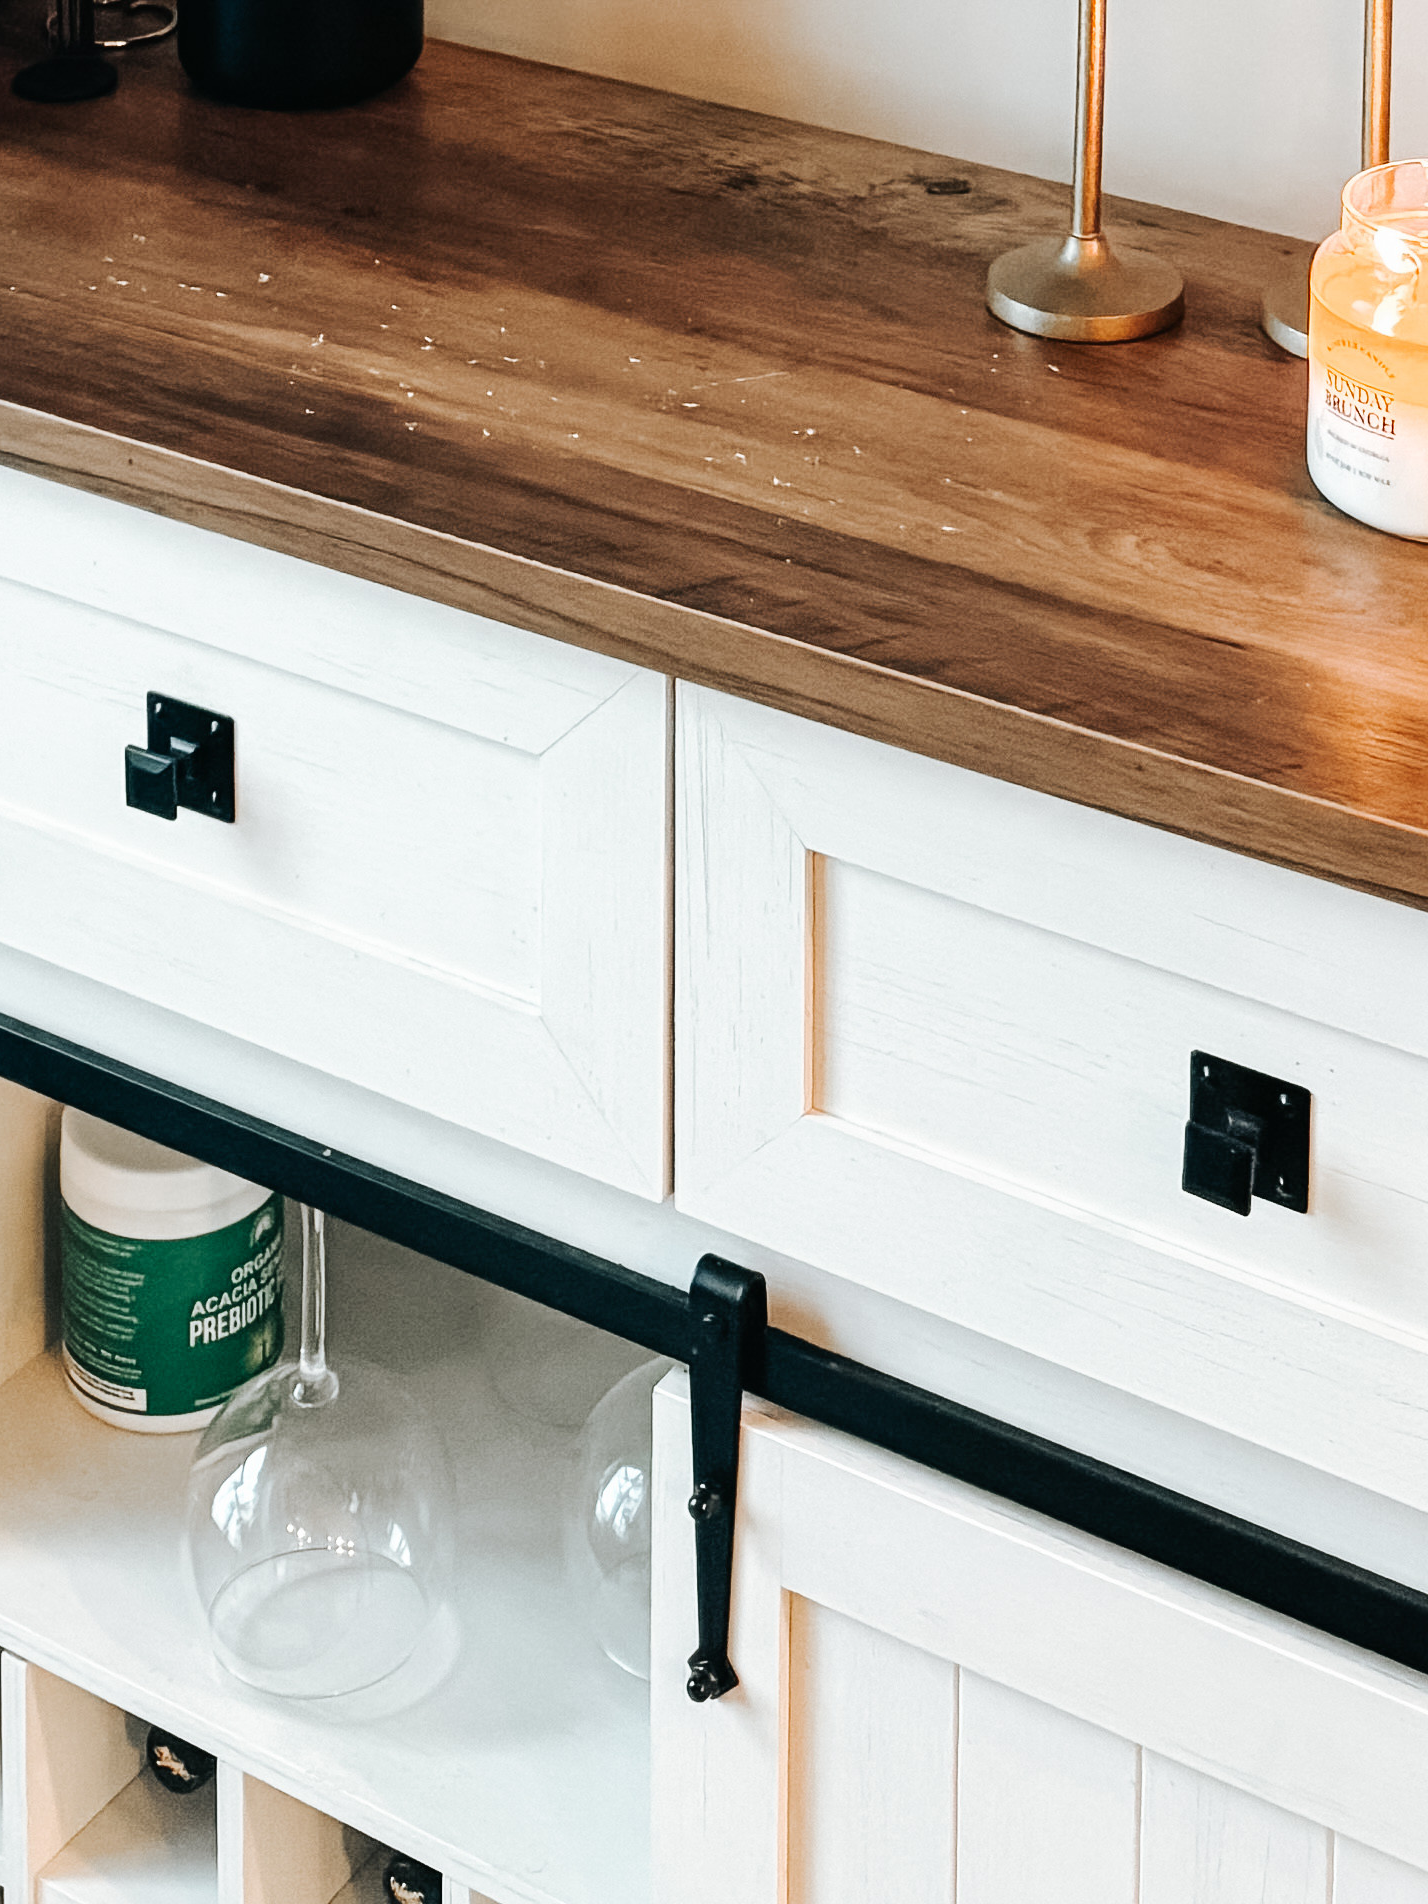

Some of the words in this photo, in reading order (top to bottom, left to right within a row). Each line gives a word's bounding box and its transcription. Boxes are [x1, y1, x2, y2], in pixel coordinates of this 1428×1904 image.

[1324, 388, 1397, 436] BRUNCH
[1325, 368, 1395, 413] SUNDAY
[188, 1277, 276, 1349] PREBIOTIC
[190, 1277, 259, 1319] ACACIA
